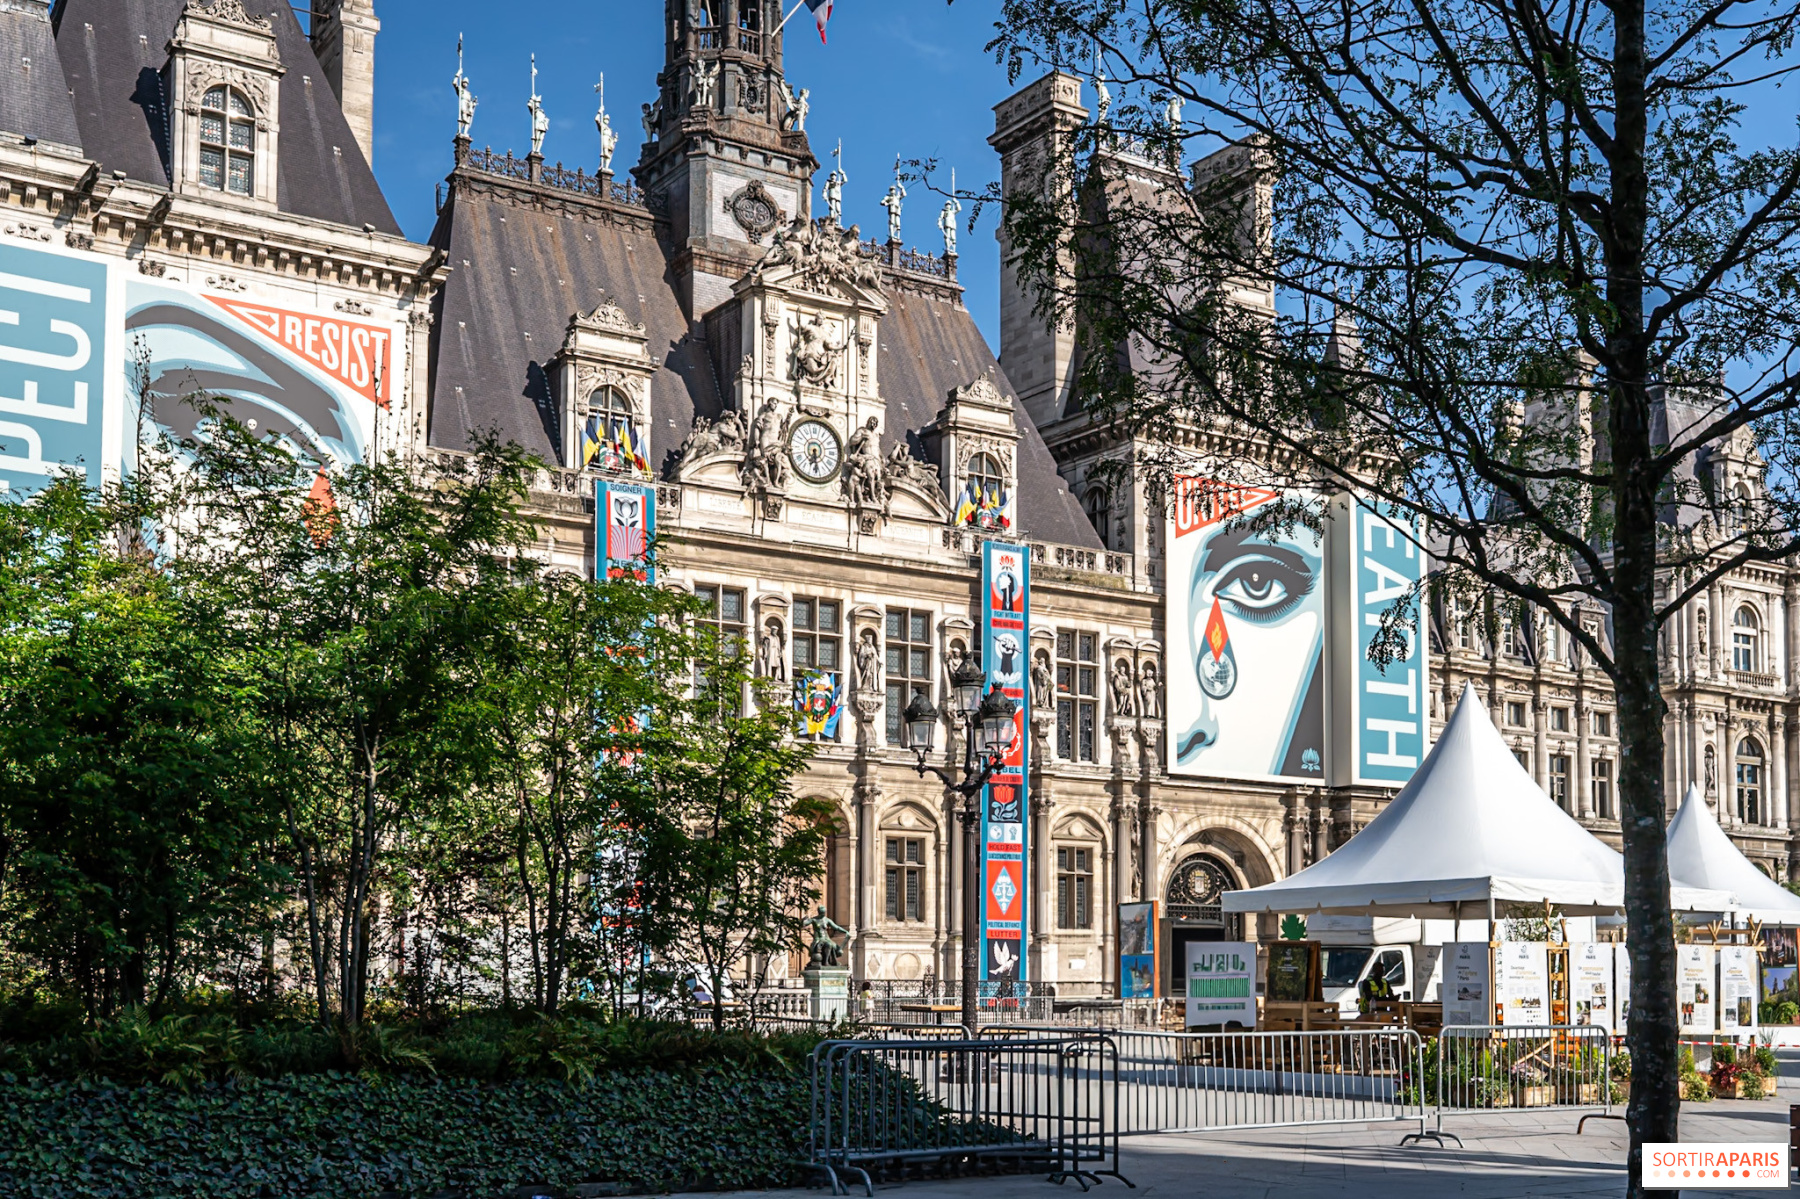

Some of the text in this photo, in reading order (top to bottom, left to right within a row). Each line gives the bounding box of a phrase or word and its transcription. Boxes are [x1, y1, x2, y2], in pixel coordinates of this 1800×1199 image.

[284, 315, 390, 398] RESIST
[610, 483, 642, 494] SOIGNER
[1363, 511, 1418, 768] EARTH
[992, 766, 1021, 774] BEL
[989, 843, 1021, 852] HOLD FAST
[990, 930, 1018, 938] LUTTER
